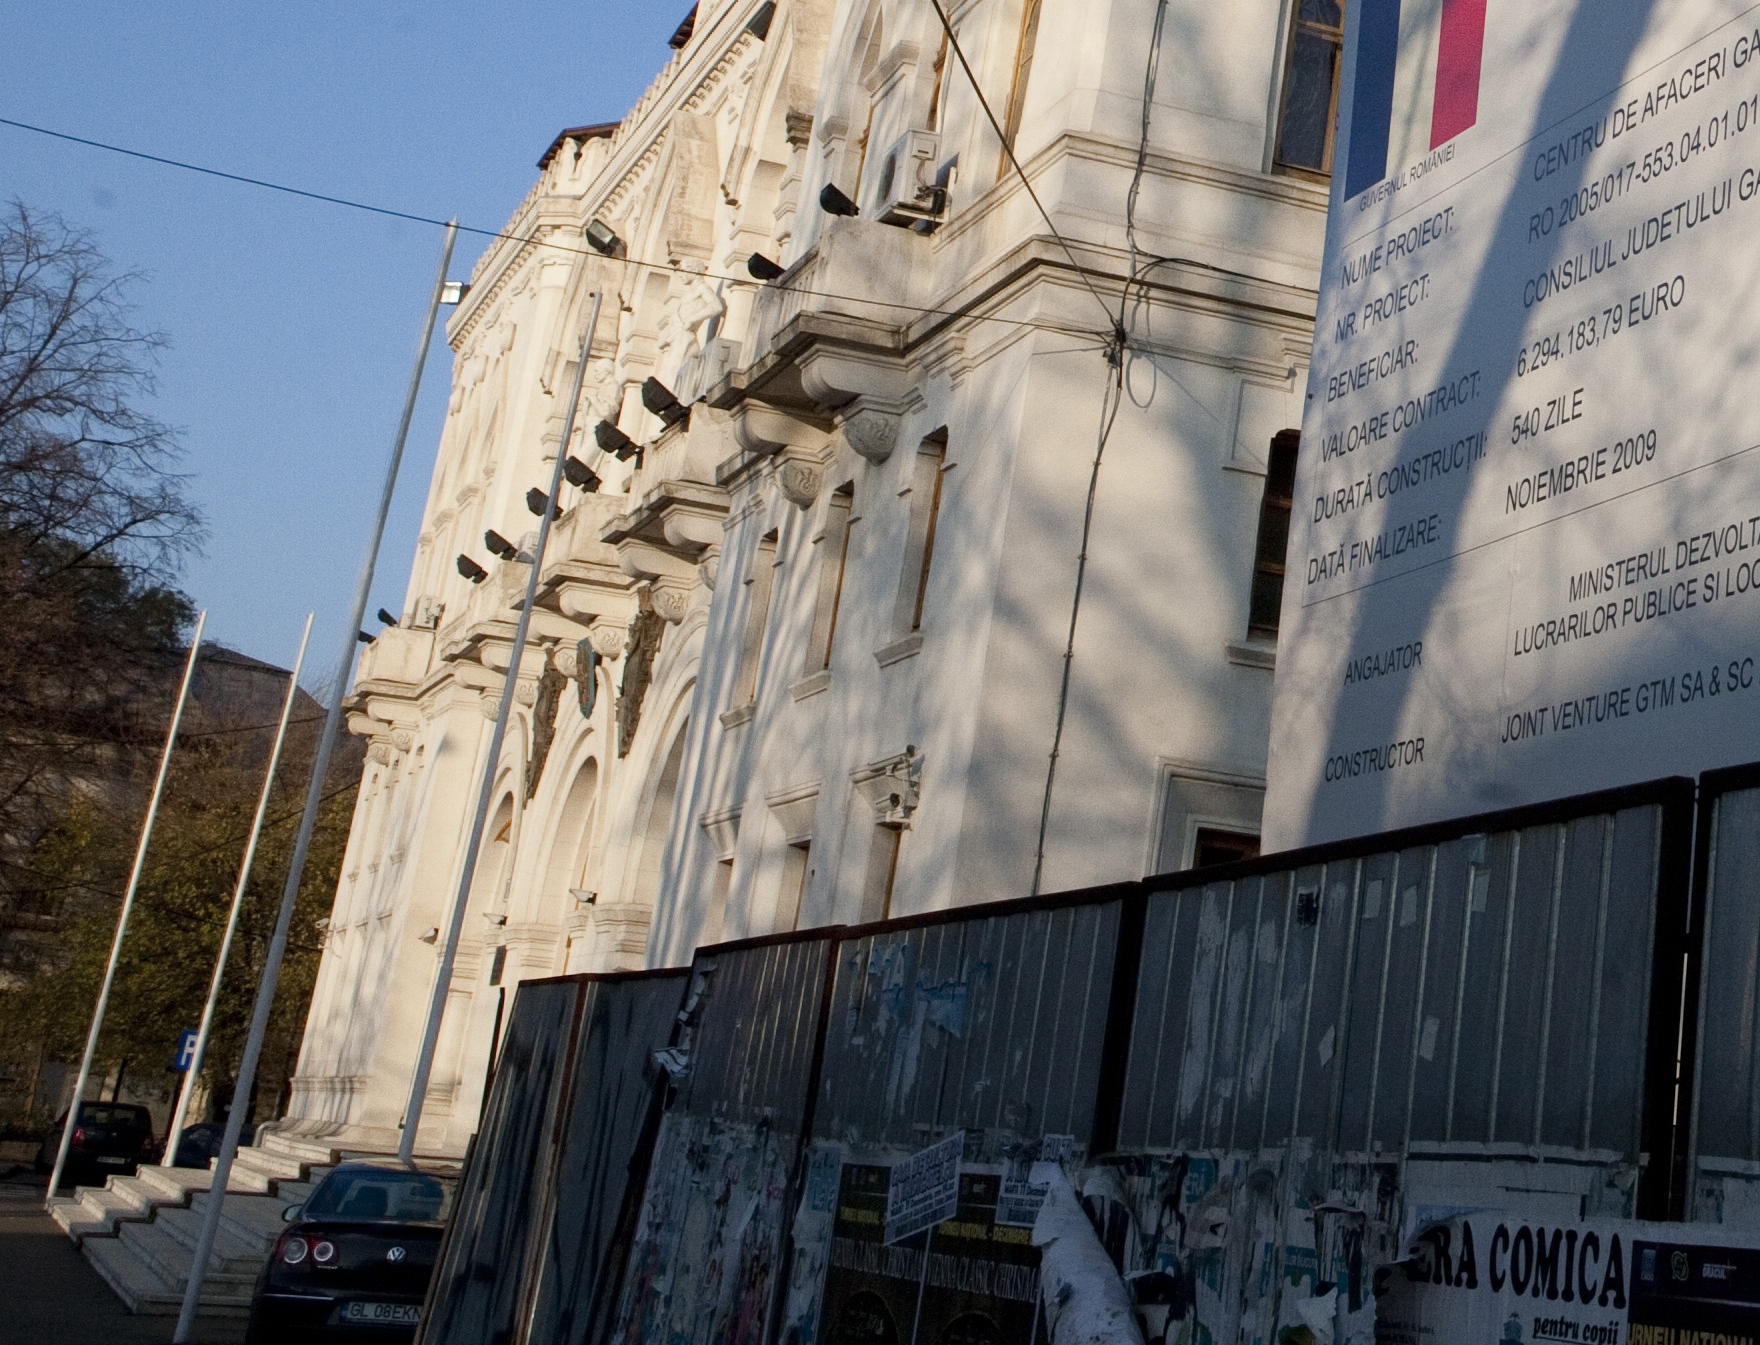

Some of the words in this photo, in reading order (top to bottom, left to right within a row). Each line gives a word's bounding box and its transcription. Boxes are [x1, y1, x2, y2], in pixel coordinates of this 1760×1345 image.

[1533, 117, 1608, 183] CENTRU
[1611, 98, 1639, 140] DE
[1640, 47, 1727, 124] AFACERI
[1340, 244, 1384, 290] NUME
[1385, 205, 1455, 267] PROIECT:
[1522, 238, 1618, 310] CONSILIUL
[1620, 177, 1733, 262] JUDETULUI
[1528, 206, 1555, 244] RO
[1334, 310, 1358, 344] NR.
[1363, 272, 1431, 326] PROIECT:
[1516, 303, 1624, 378] 6.294.183,79
[1627, 274, 1686, 329] EURO
[1326, 338, 1420, 404] BENEFICIAR:
[1321, 410, 1390, 464] VALOARE
[1392, 369, 1482, 434] CONTRACT:
[1510, 406, 1541, 446] 540
[1543, 386, 1585, 433] ZILE
[1313, 471, 1375, 527] DURATĂ
[1505, 446, 1609, 515] NOIEMBRIE
[1611, 428, 1658, 476] 2009
[1306, 541, 1346, 586] DATĂ
[1348, 513, 1443, 572] FINALIZARE:
[1568, 546, 1671, 603] MINISTERUL
[1513, 601, 1618, 657] LUCRARILOR
[1621, 577, 1699, 627] PUBLICE
[1702, 570, 1721, 604] SI
[1343, 640, 1424, 687] ANGAJATOR
[1324, 736, 1426, 784] CONSTRUCTOR
[1490, 1224, 1626, 1310] COMICA
[351, 1304, 368, 1317] GL
[1532, 1315, 1580, 1339] pentru
[1582, 1322, 1618, 1345] copii
